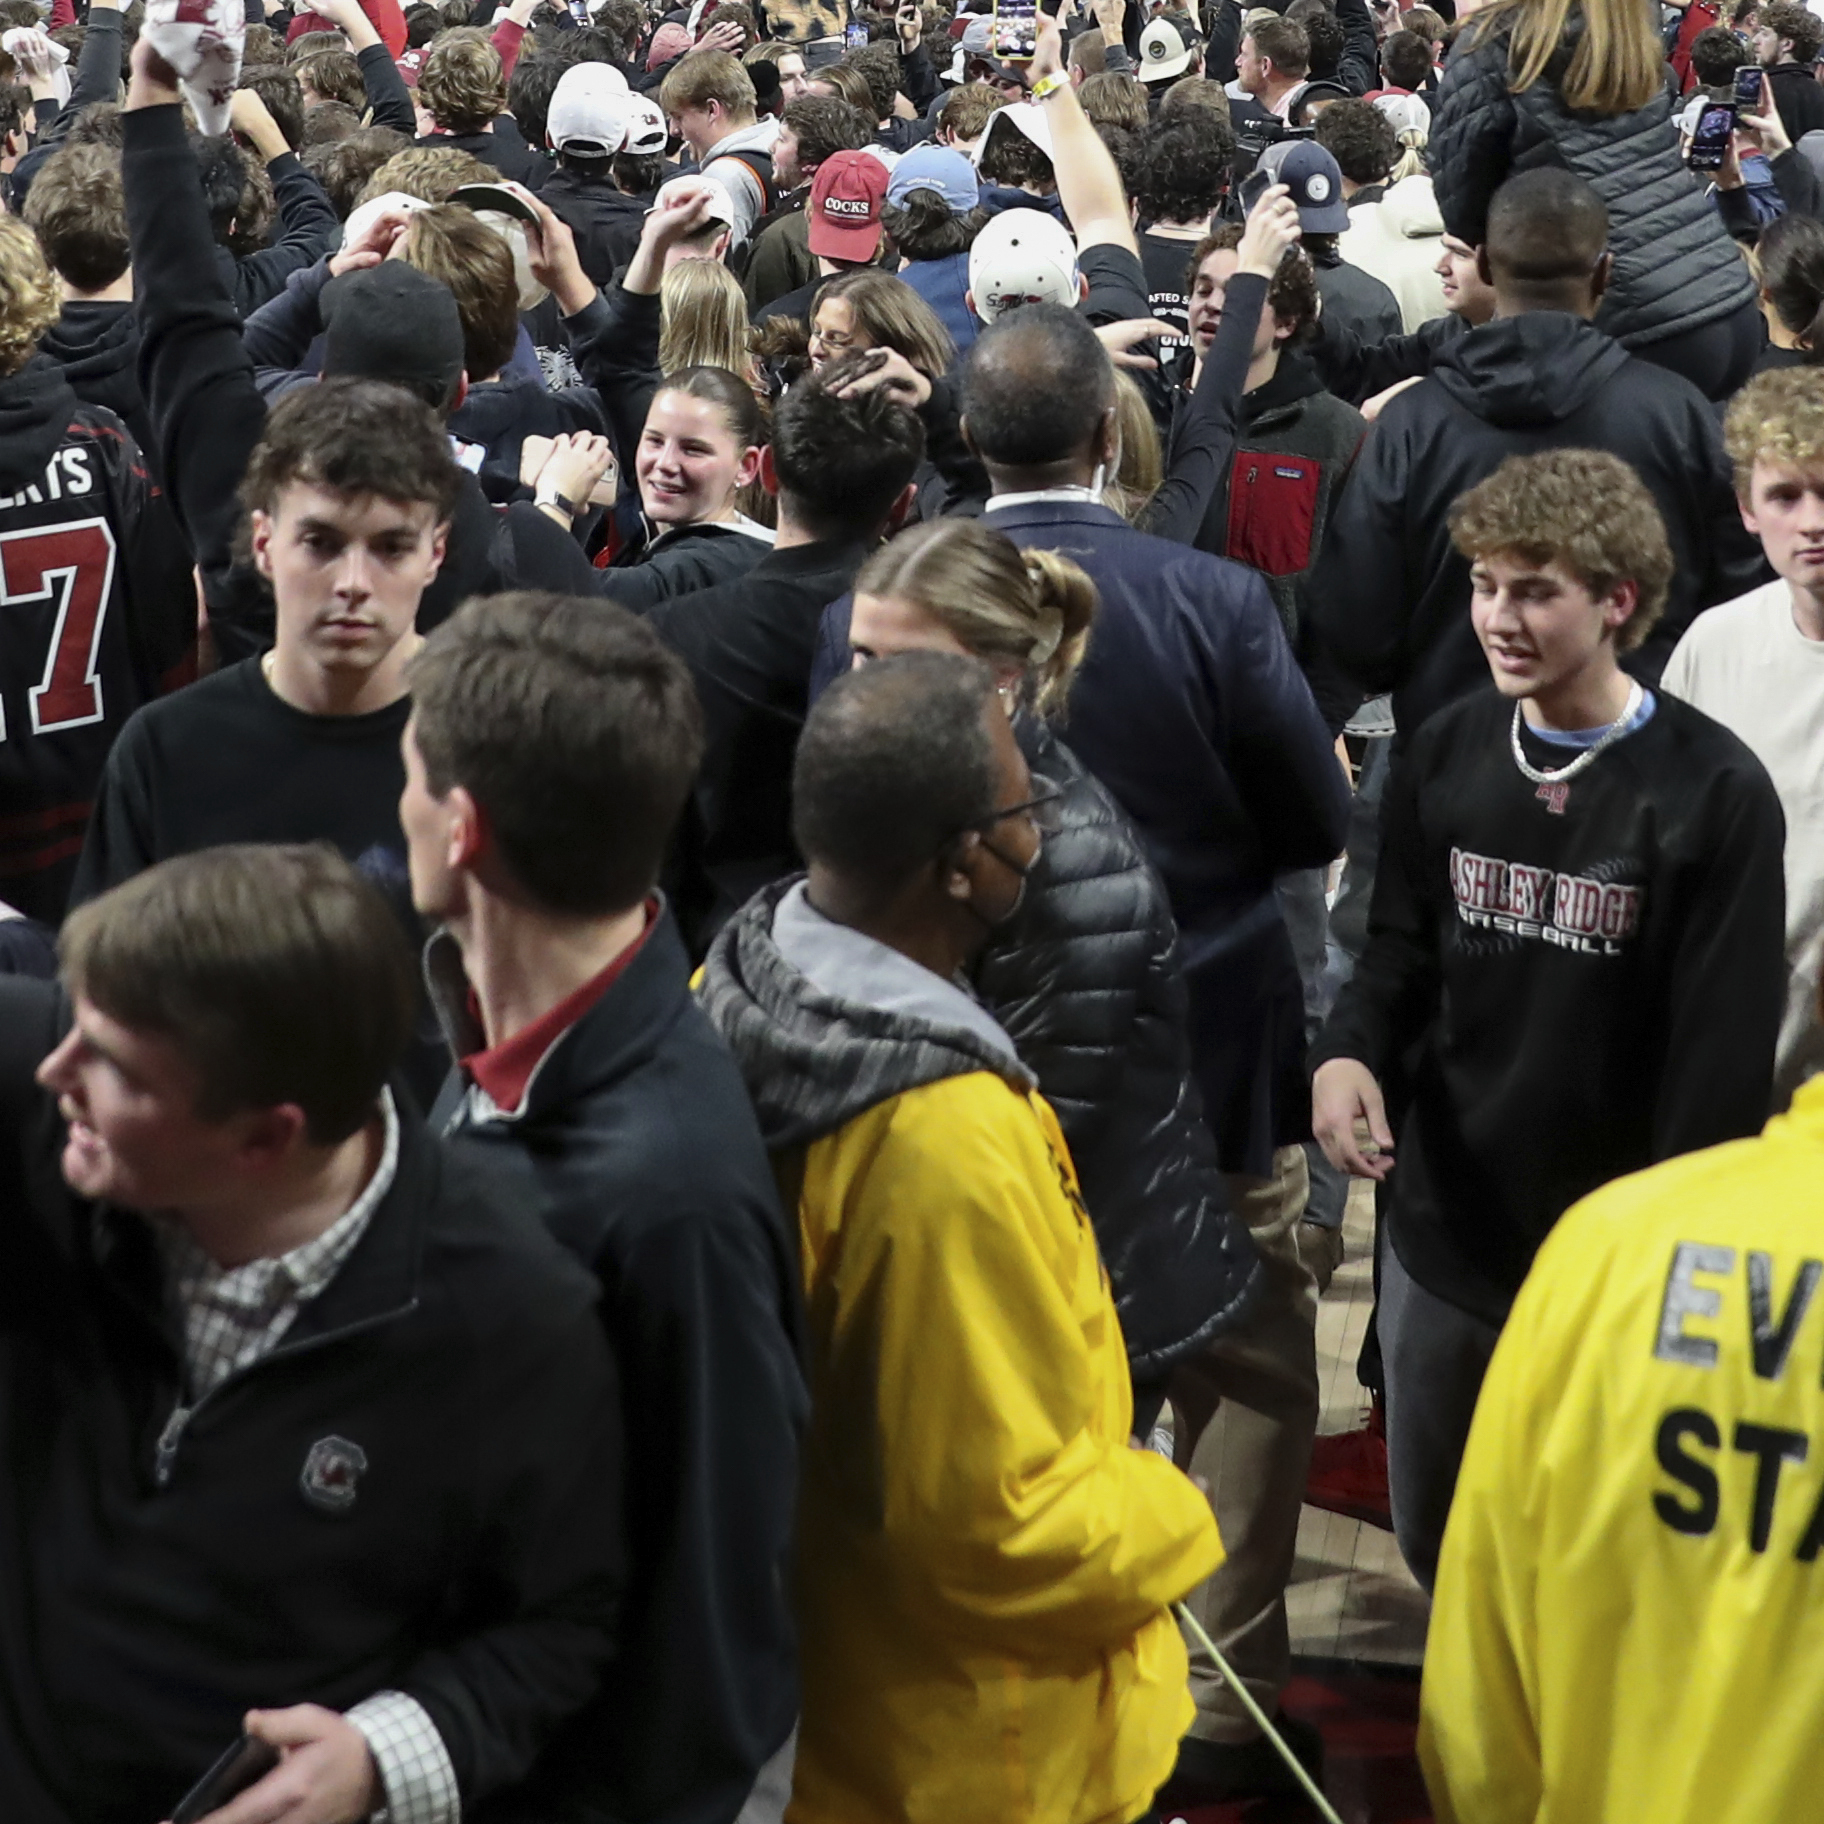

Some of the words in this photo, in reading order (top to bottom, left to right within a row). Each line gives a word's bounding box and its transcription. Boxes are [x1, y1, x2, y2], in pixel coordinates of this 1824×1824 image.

[825, 197, 869, 214] COCKS
[1148, 293, 1180, 304] AFTED
[1450, 846, 1555, 921] ASHLEY
[1553, 873, 1642, 939] RIDGE
